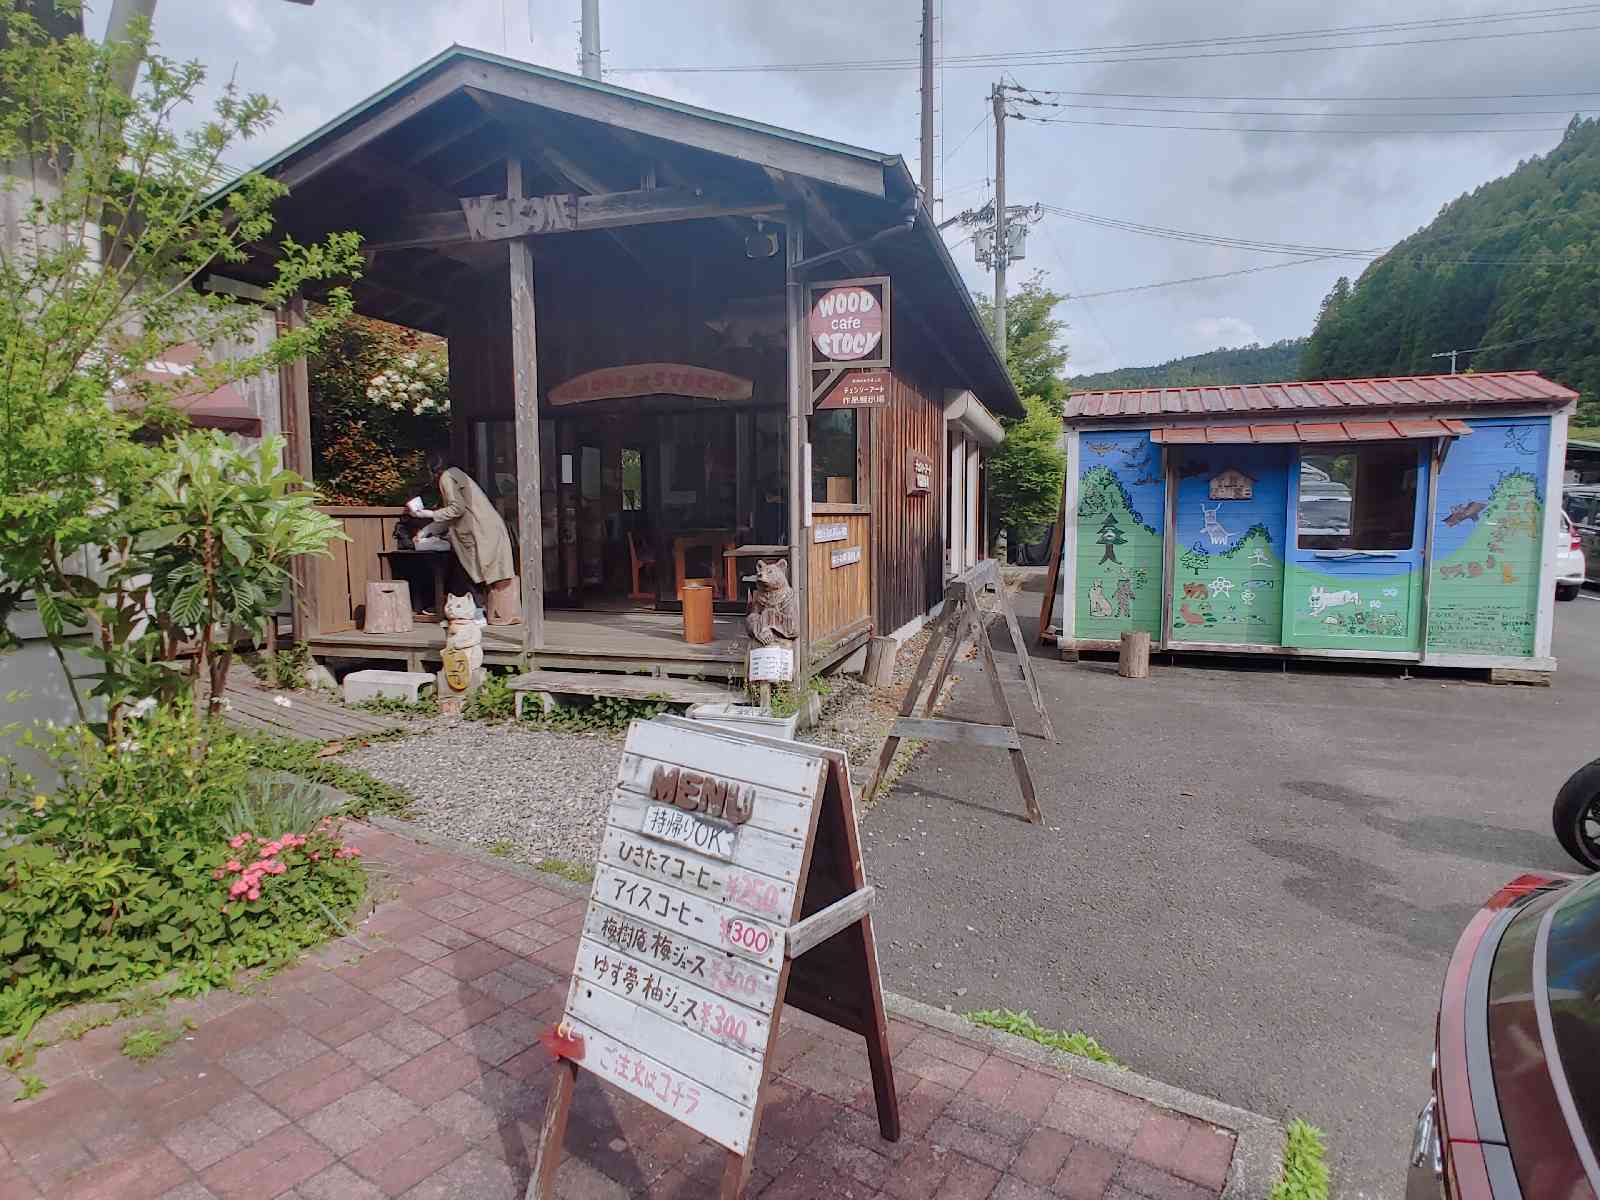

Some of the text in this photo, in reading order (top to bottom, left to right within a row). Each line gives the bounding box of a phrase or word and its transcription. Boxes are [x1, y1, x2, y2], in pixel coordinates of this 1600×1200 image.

[819, 291, 875, 317] WOOD
[831, 317, 862, 330] cafe
[817, 331, 882, 355] STOCK
[649, 763, 757, 825] MENU
[619, 841, 721, 890] ひきたてコーヒー
[614, 878, 704, 925] アイスコーヒー
[702, 1001, 748, 1041] ¥300
[600, 1046, 702, 1115] ご注文はコチラ
